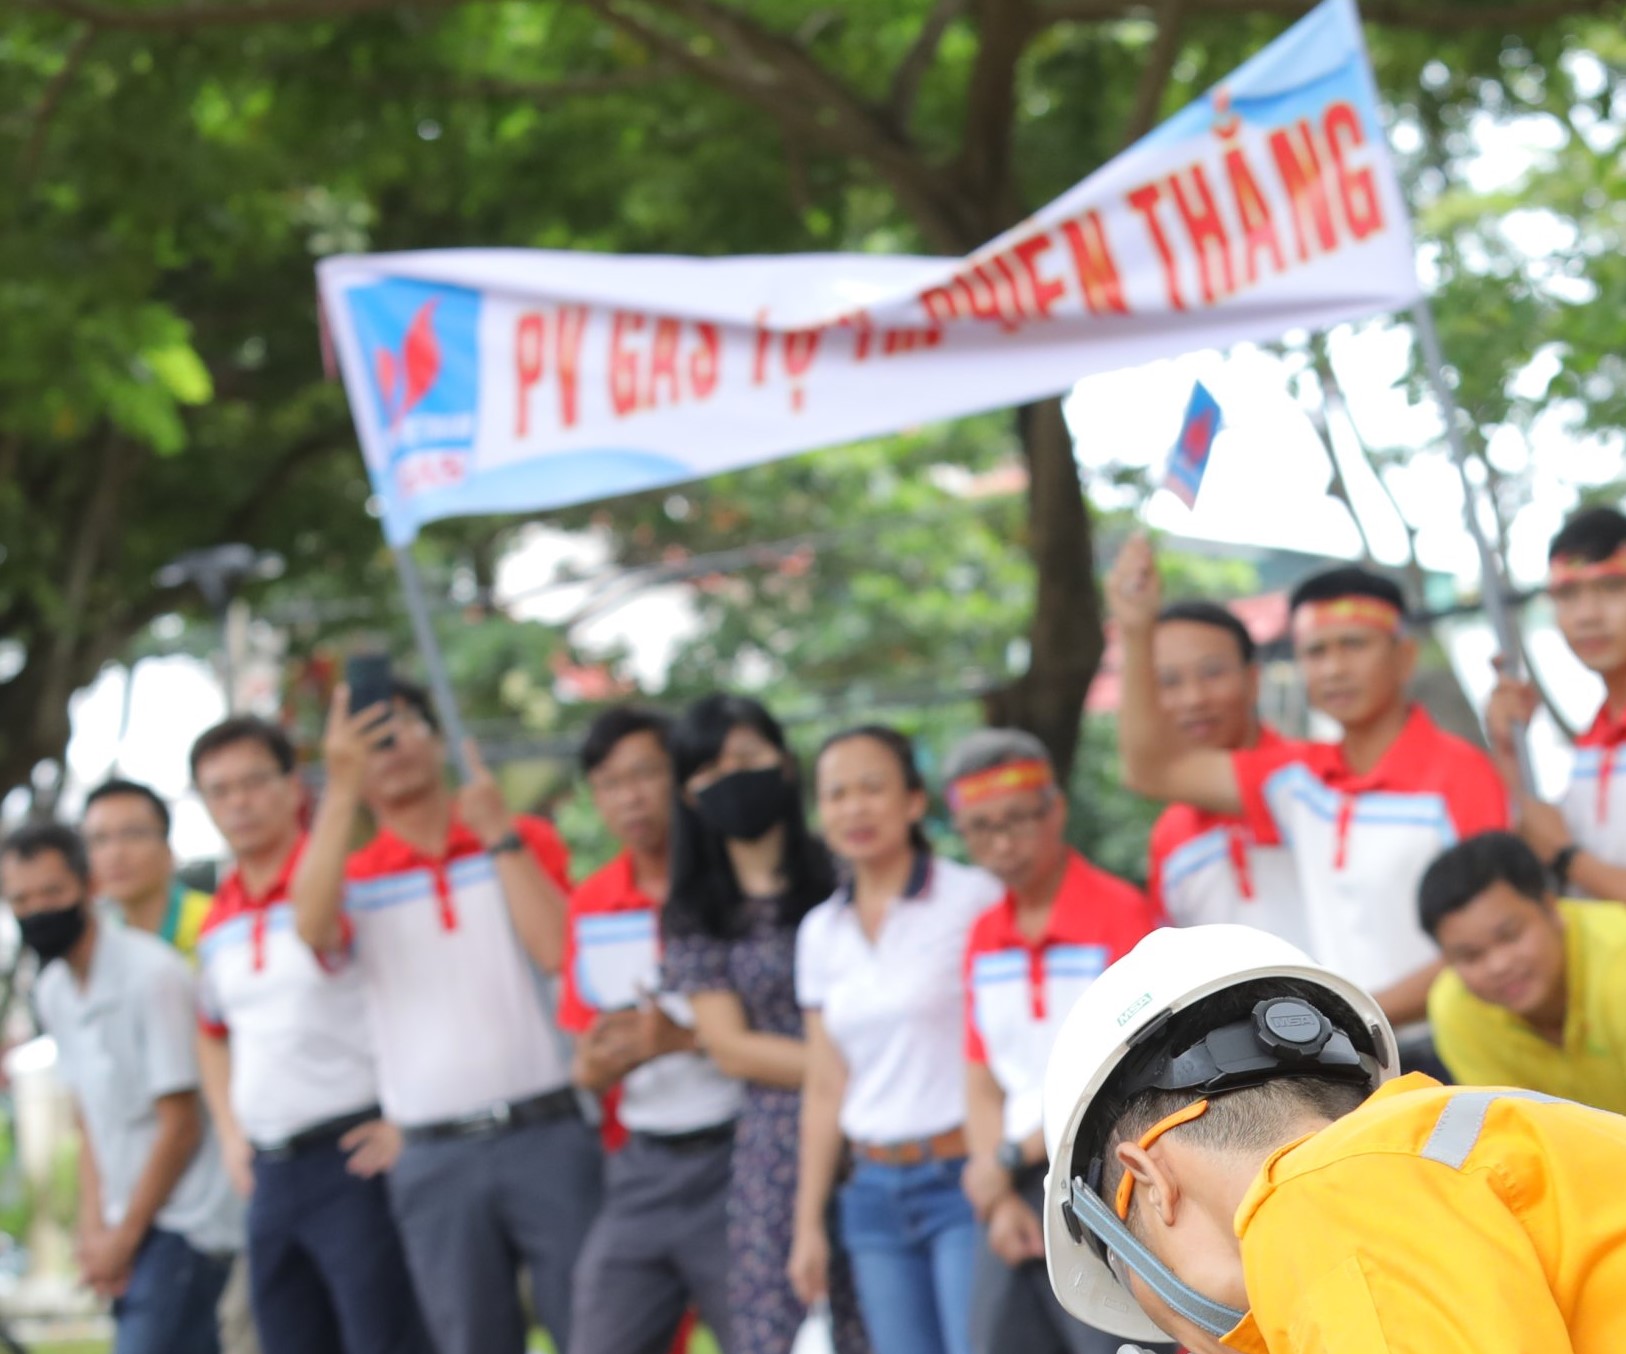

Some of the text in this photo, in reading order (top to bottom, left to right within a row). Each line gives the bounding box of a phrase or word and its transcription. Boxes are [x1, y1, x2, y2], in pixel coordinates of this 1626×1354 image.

[513, 304, 589, 438] PV
[609, 309, 720, 418] GAS
[1118, 994, 1151, 1026] MSA
[1272, 1014, 1315, 1028] MSA
